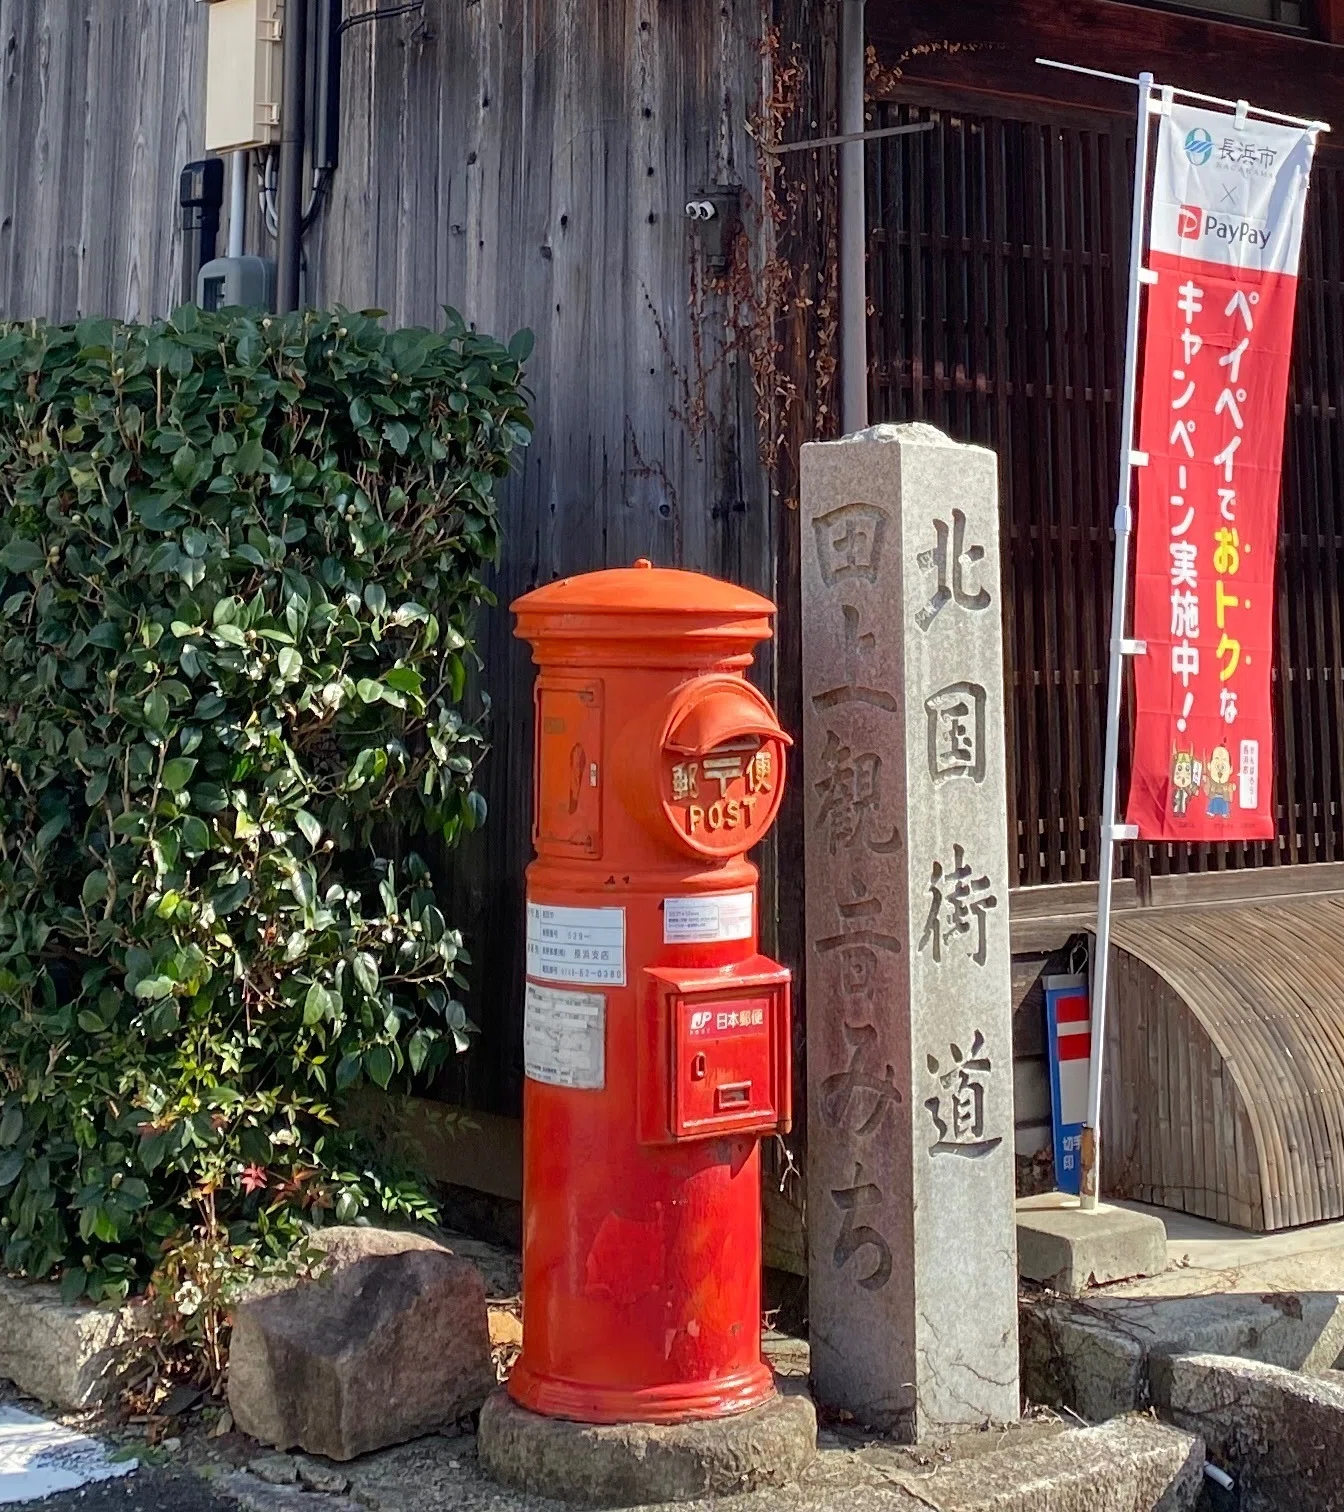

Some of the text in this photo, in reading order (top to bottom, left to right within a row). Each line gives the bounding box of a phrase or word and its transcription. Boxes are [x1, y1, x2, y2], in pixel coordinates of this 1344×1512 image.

[1218, 138, 1277, 169] 長浜市
[1205, 216, 1271, 249] PayPay
[1213, 291, 1258, 724] ペイペイでおトクな
[687, 796, 757, 833] POST
[915, 508, 1003, 1159] 北国街道
[716, 1009, 763, 1030] 日本郵便
